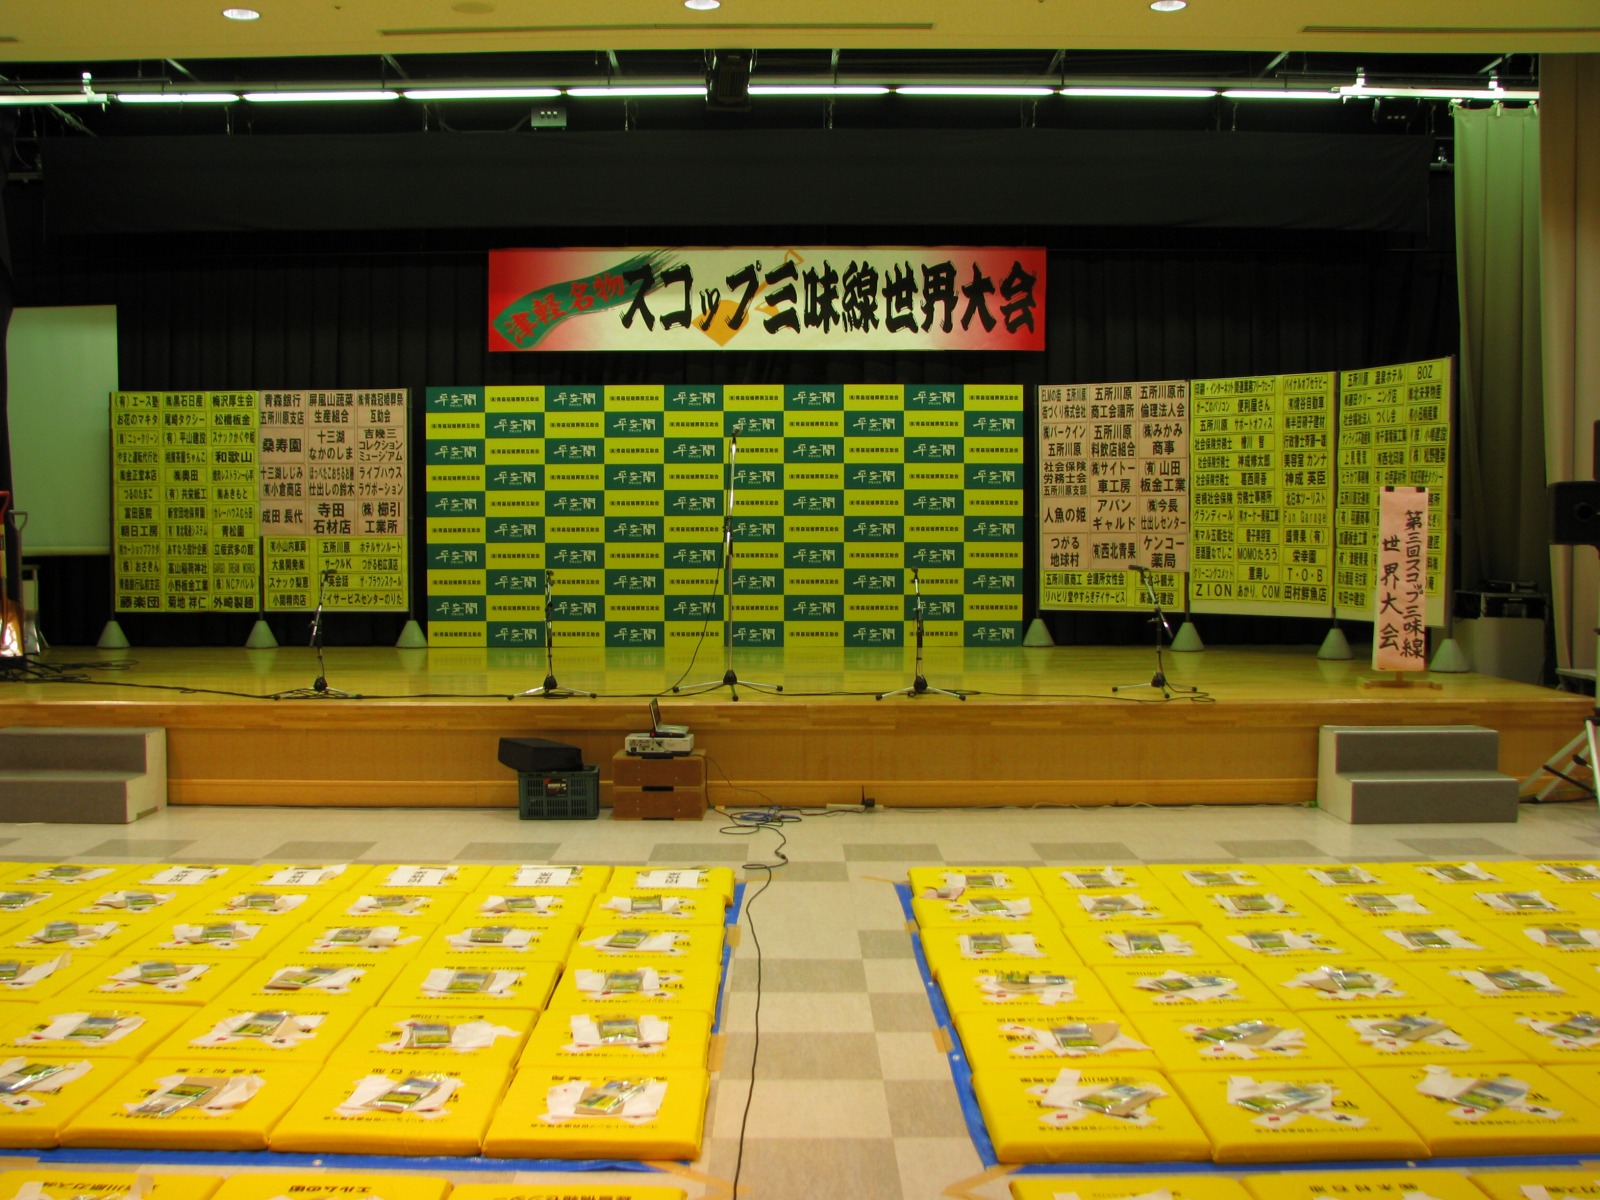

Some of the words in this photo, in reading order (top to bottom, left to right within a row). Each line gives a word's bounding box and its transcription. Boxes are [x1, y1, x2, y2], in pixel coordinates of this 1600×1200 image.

[618, 259, 1037, 336] スコップ三味線世界大会
[1095, 388, 1132, 400] 五所川原
[1140, 385, 1185, 399] 五所川原市
[265, 394, 301, 407] 青森銀行
[315, 409, 348, 423] 生産組合
[370, 410, 390, 422] 互助会
[1043, 406, 1086, 418] 街づくり株式会社
[1091, 404, 1134, 418] 商工会議所
[1141, 403, 1185, 418] 倫理法人会
[118, 414, 158, 425] お花のマキタ
[215, 414, 250, 425] 松橋板金
[261, 411, 304, 424] 五所川原支店
[1200, 419, 1227, 431] 五所川原
[318, 430, 345, 443] 十三湖
[364, 429, 396, 438] 吉幾三
[1094, 425, 1132, 439] 五所川原
[263, 439, 301, 452] 桑寿園
[360, 441, 402, 450] コレクション
[1048, 443, 1081, 456] 五所川原
[1092, 442, 1135, 457] 料飲店組合
[1153, 441, 1174, 455] 商事
[215, 451, 252, 463] 和歌山
[310, 447, 352, 459] なかのしま
[360, 452, 402, 461] ミュージアム
[1044, 462, 1086, 472] 社会保険
[1284, 454, 1303, 467] 美容室
[1307, 454, 1326, 467] カンナ
[261, 467, 303, 479] 十三湖しじみ
[359, 467, 402, 479] ライブハウス
[1044, 473, 1086, 483] 労務士会
[309, 483, 354, 496] 仕出しの鈴木
[1044, 485, 1087, 496] 五所川原支部
[1098, 479, 1130, 493] 車工房
[1141, 479, 1185, 492] 板金工業
[318, 503, 344, 517] 寺田
[1098, 500, 1131, 512] アバン
[263, 510, 280, 523] 成田
[284, 510, 303, 523] 長代
[1044, 507, 1086, 523] 人魚の姫
[314, 520, 351, 534] 石材店
[365, 520, 397, 533] 工業所
[1093, 517, 1135, 530] ギャルド
[1141, 516, 1186, 530] 仕出しセンター
[121, 526, 158, 537] 朝日工房
[222, 526, 244, 537] 青松園
[323, 542, 350, 553] 五所川原
[360, 542, 401, 552] ホテルサンルート
[1051, 537, 1079, 549] つがる
[1144, 535, 1184, 550] ケンコー
[325, 559, 351, 569] サークルK
[1051, 553, 1079, 567] 地球村
[1152, 554, 1176, 568] 薬局
[1196, 584, 1232, 596] ZION
[1400, 510, 1425, 659] 第三回スコップ三味線
[1379, 534, 1403, 651] 世界大会
